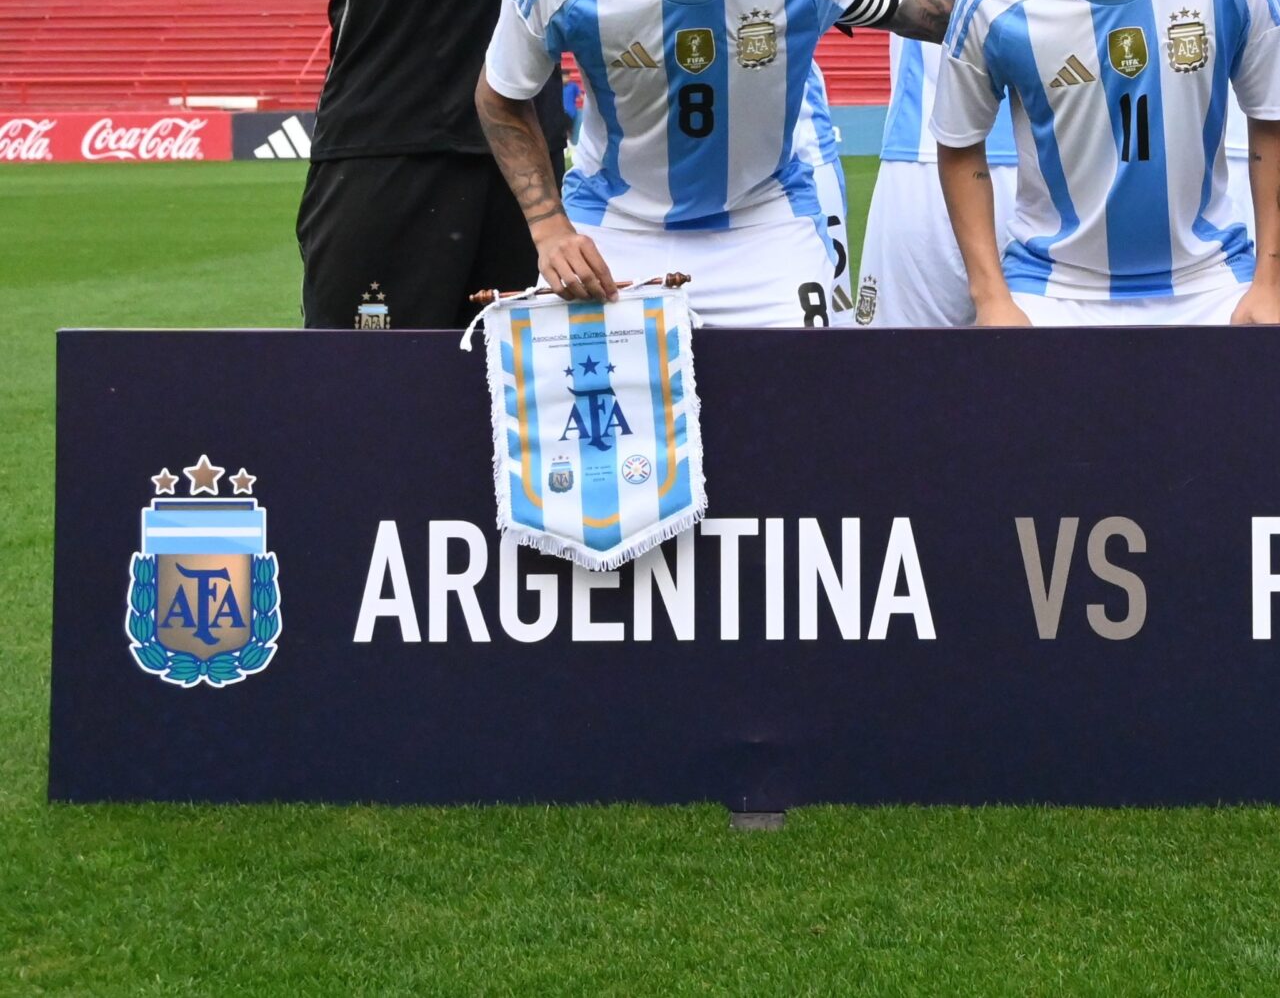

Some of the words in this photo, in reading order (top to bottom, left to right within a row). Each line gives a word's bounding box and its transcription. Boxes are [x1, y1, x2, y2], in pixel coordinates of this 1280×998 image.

[746, 35, 768, 55] AFA
[1121, 58, 1139, 67] FIFA
[1178, 36, 1200, 58] AFA
[678, 83, 714, 138] 8
[1120, 93, 1150, 162] 11
[81, 118, 207, 160] Coca-Cola
[798, 282, 829, 327] 8
[558, 386, 634, 451] AFA
[158, 562, 247, 646] AFA
[353, 517, 937, 643] ARGENTINA
[1014, 516, 1147, 641] VS
